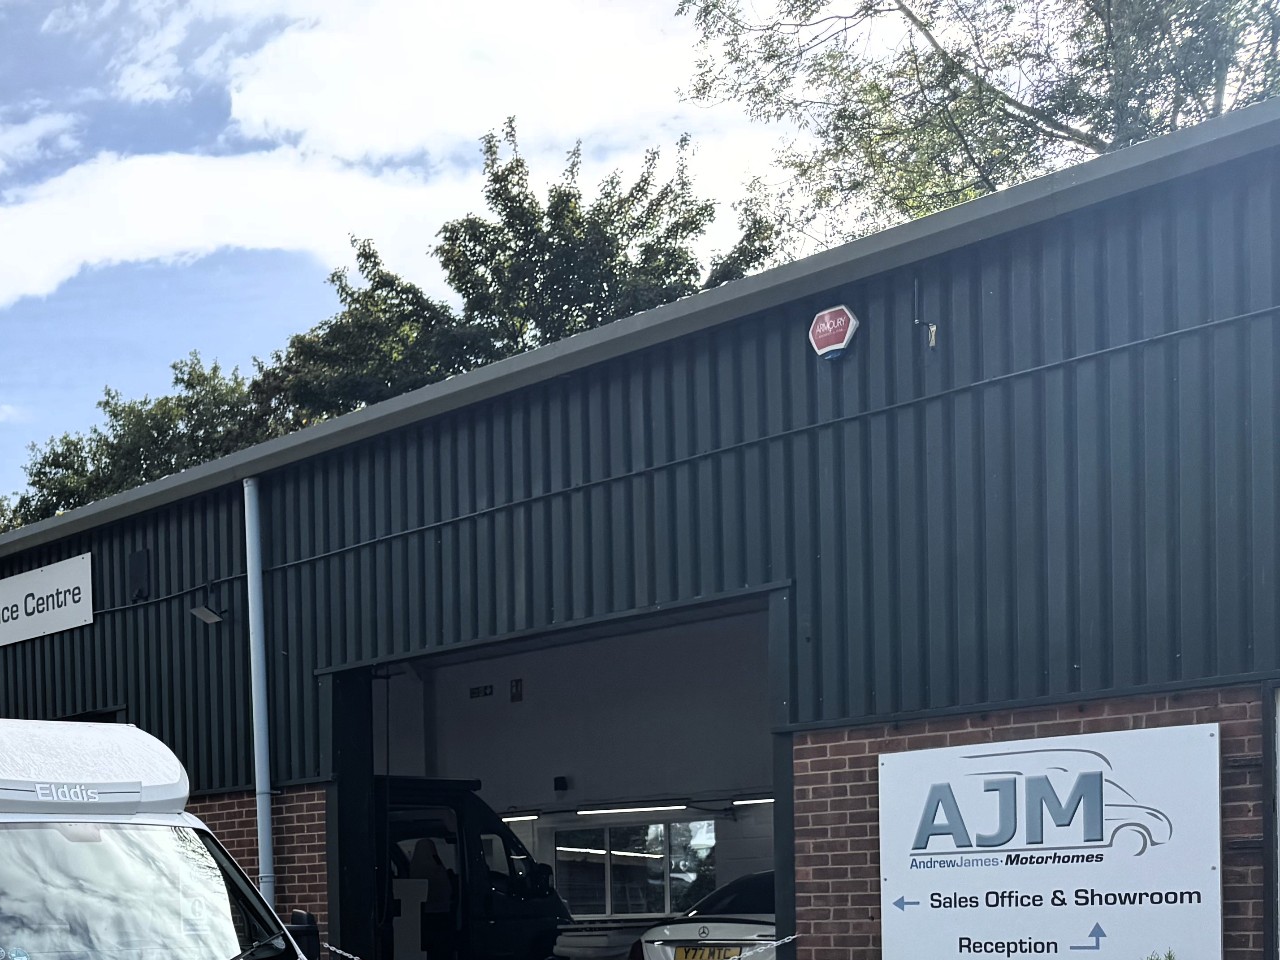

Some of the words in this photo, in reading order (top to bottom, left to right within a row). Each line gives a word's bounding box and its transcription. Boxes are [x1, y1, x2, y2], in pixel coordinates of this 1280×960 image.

[24, 585, 82, 617] Centre
[35, 783, 100, 802] Elddis
[911, 770, 1105, 851] AJM
[930, 892, 979, 909] Sales
[985, 889, 1044, 908] Office
[1050, 889, 1068, 907] &
[1074, 888, 1202, 906] Showroom
[684, 947, 705, 959] Y77
[958, 936, 1058, 957] Reception
